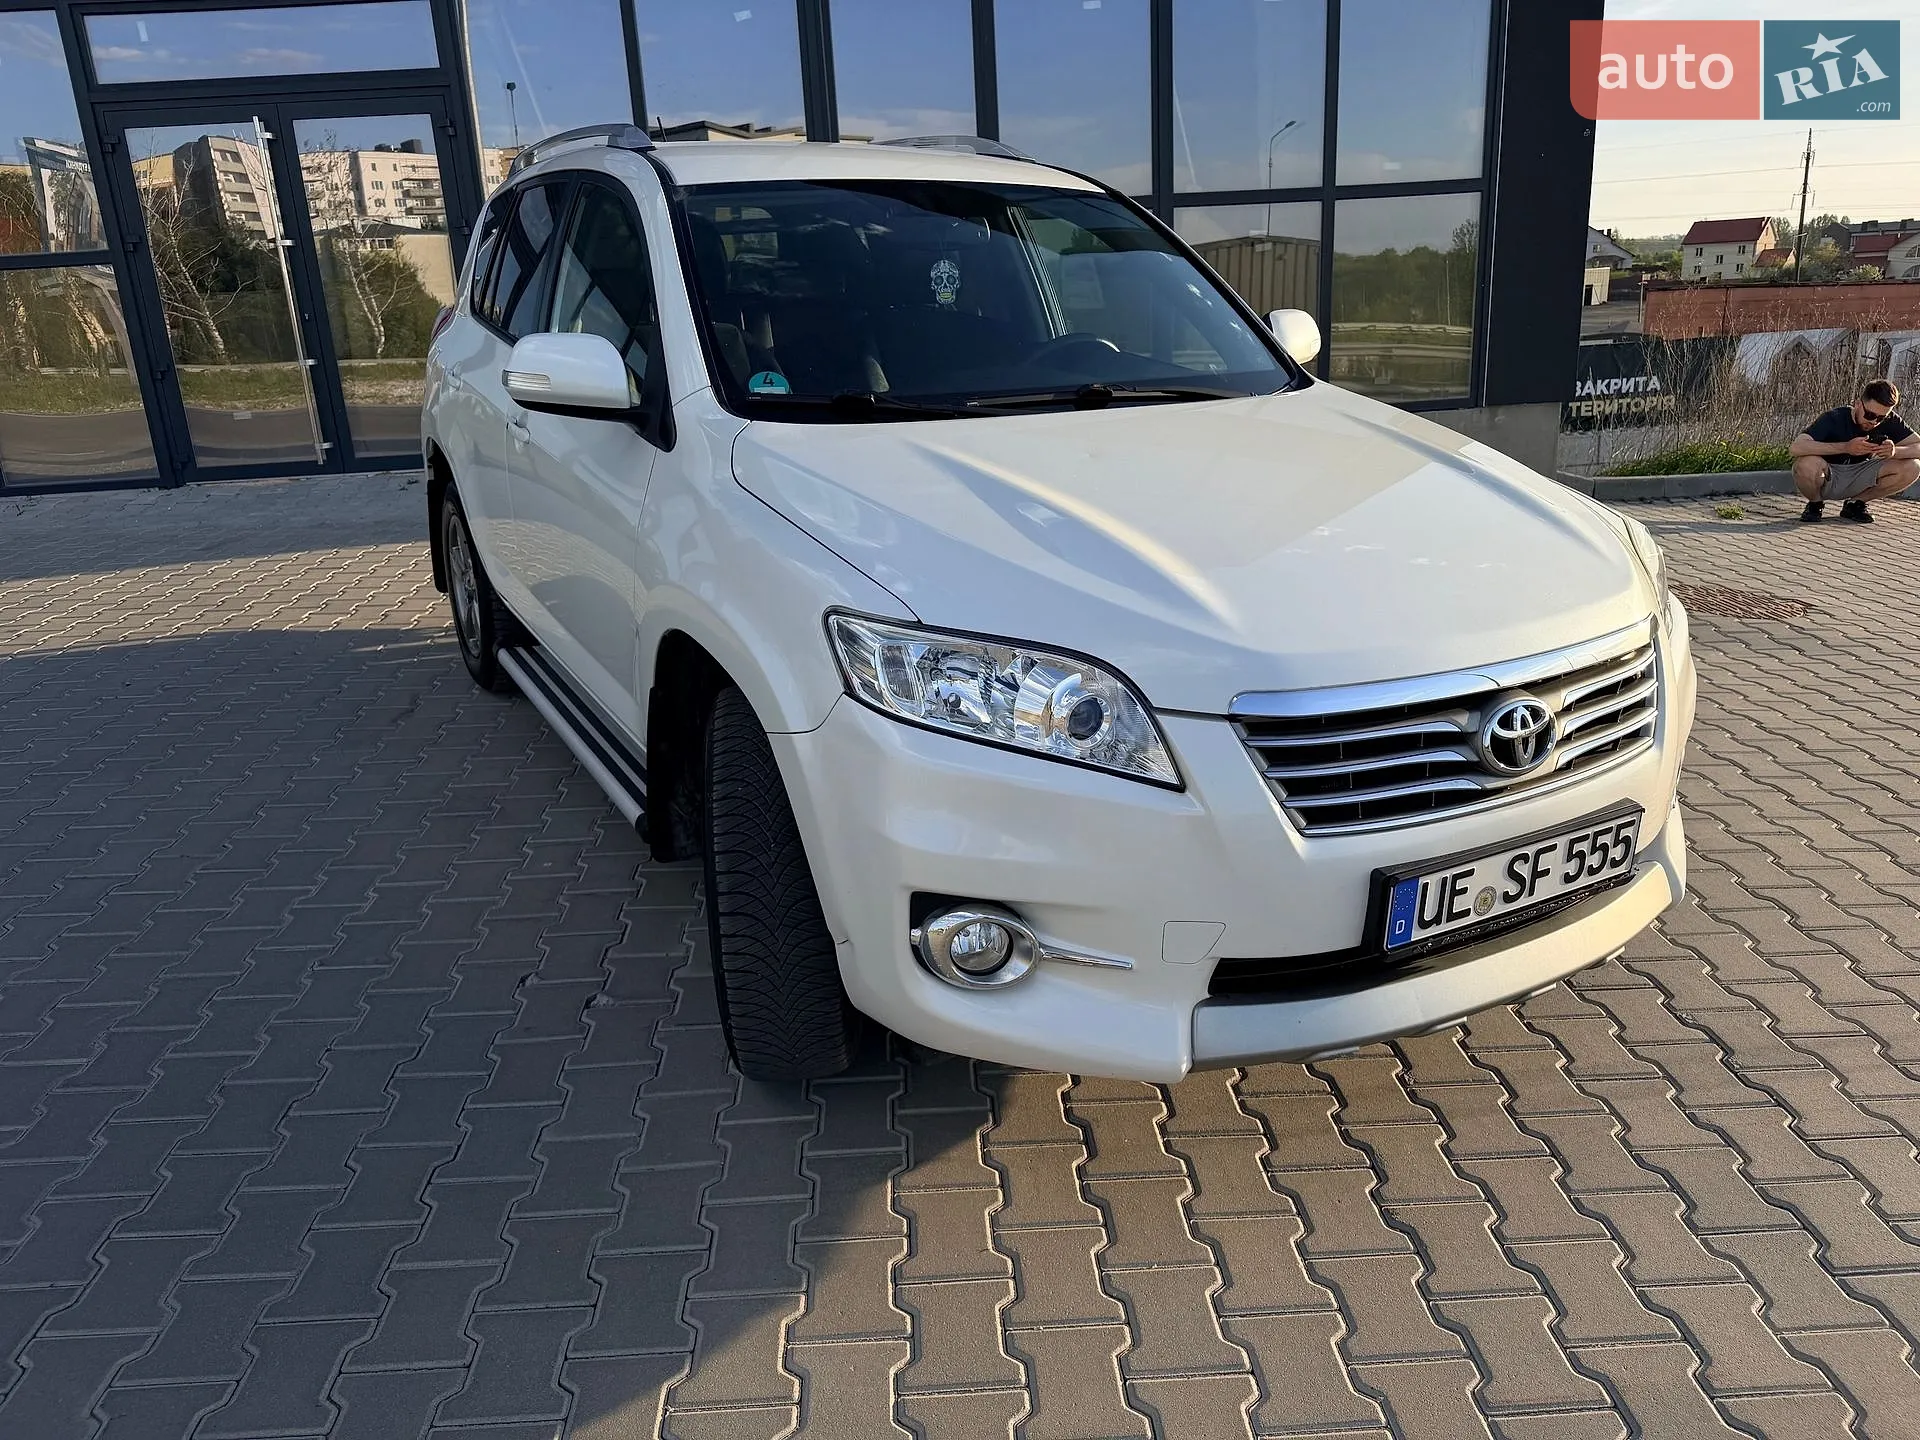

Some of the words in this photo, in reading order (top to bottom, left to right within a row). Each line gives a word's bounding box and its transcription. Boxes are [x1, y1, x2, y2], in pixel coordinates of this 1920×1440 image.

[763, 372, 775, 387] 4
[1569, 395, 1676, 417] ТЕРИТОРІЯ
[1417, 867, 1475, 930] UE
[1502, 843, 1558, 904] SF
[1563, 819, 1637, 884] 555
[1395, 919, 1405, 934] D
